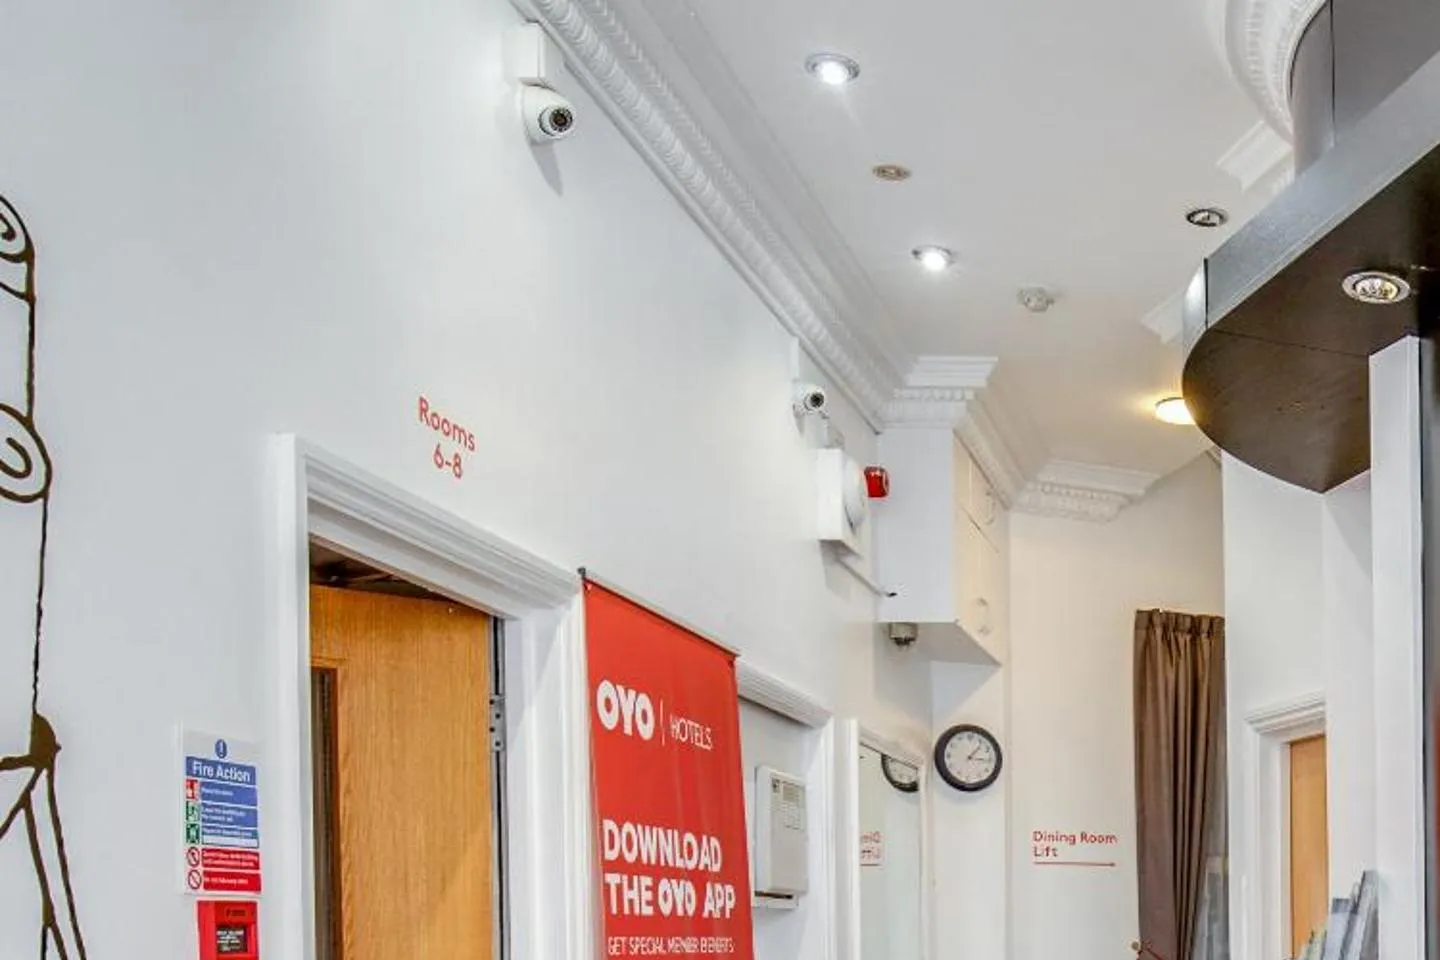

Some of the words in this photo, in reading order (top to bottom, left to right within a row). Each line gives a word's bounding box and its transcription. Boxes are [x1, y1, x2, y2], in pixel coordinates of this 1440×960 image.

[418, 395, 476, 452] Rooms
[433, 443, 462, 479] 6-8
[596, 679, 655, 741] OYO
[669, 714, 713, 752] HOTELS
[192, 760, 214, 778] Fire
[215, 764, 252, 782] Action
[602, 818, 723, 873] DOWNLOAD
[1032, 830, 1077, 846] Dining
[1079, 831, 1118, 844] Room
[1033, 846, 1058, 857] Lift
[604, 872, 654, 916] THE
[657, 877, 697, 917] OYO
[702, 880, 736, 919] APP
[607, 936, 628, 955] GET
[628, 936, 667, 955] SPECIAL
